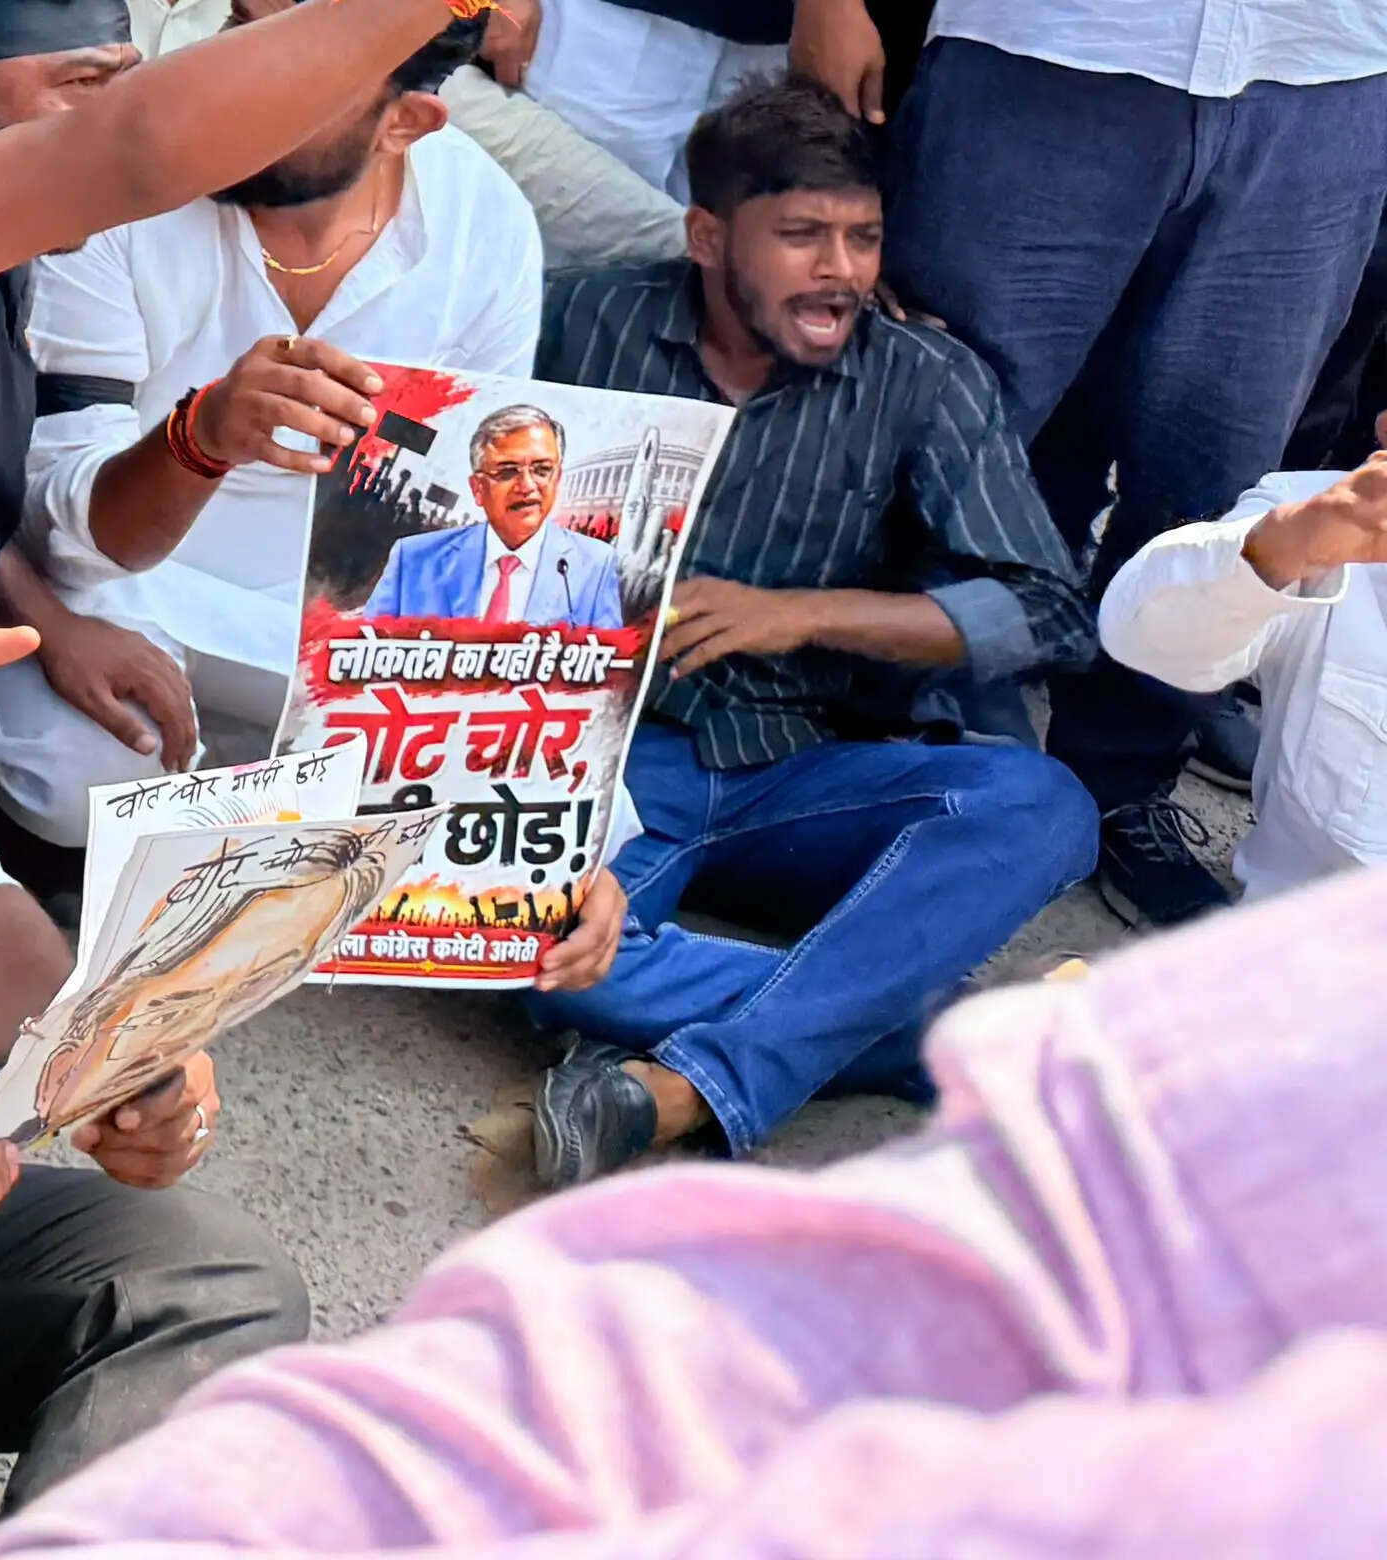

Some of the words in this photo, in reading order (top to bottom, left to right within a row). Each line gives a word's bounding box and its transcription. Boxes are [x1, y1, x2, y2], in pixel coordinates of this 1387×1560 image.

[328, 625, 454, 682] लोकतंत्र
[453, 640, 487, 679] का
[490, 630, 535, 680] यही
[536, 630, 562, 683] है
[466, 688, 591, 795] चोर,
[444, 783, 594, 884] छोड़!
[333, 933, 366, 957] ला
[370, 928, 430, 959] कांग्रेस
[433, 931, 487, 962] कमेटी
[490, 935, 540, 962] अमेठी
